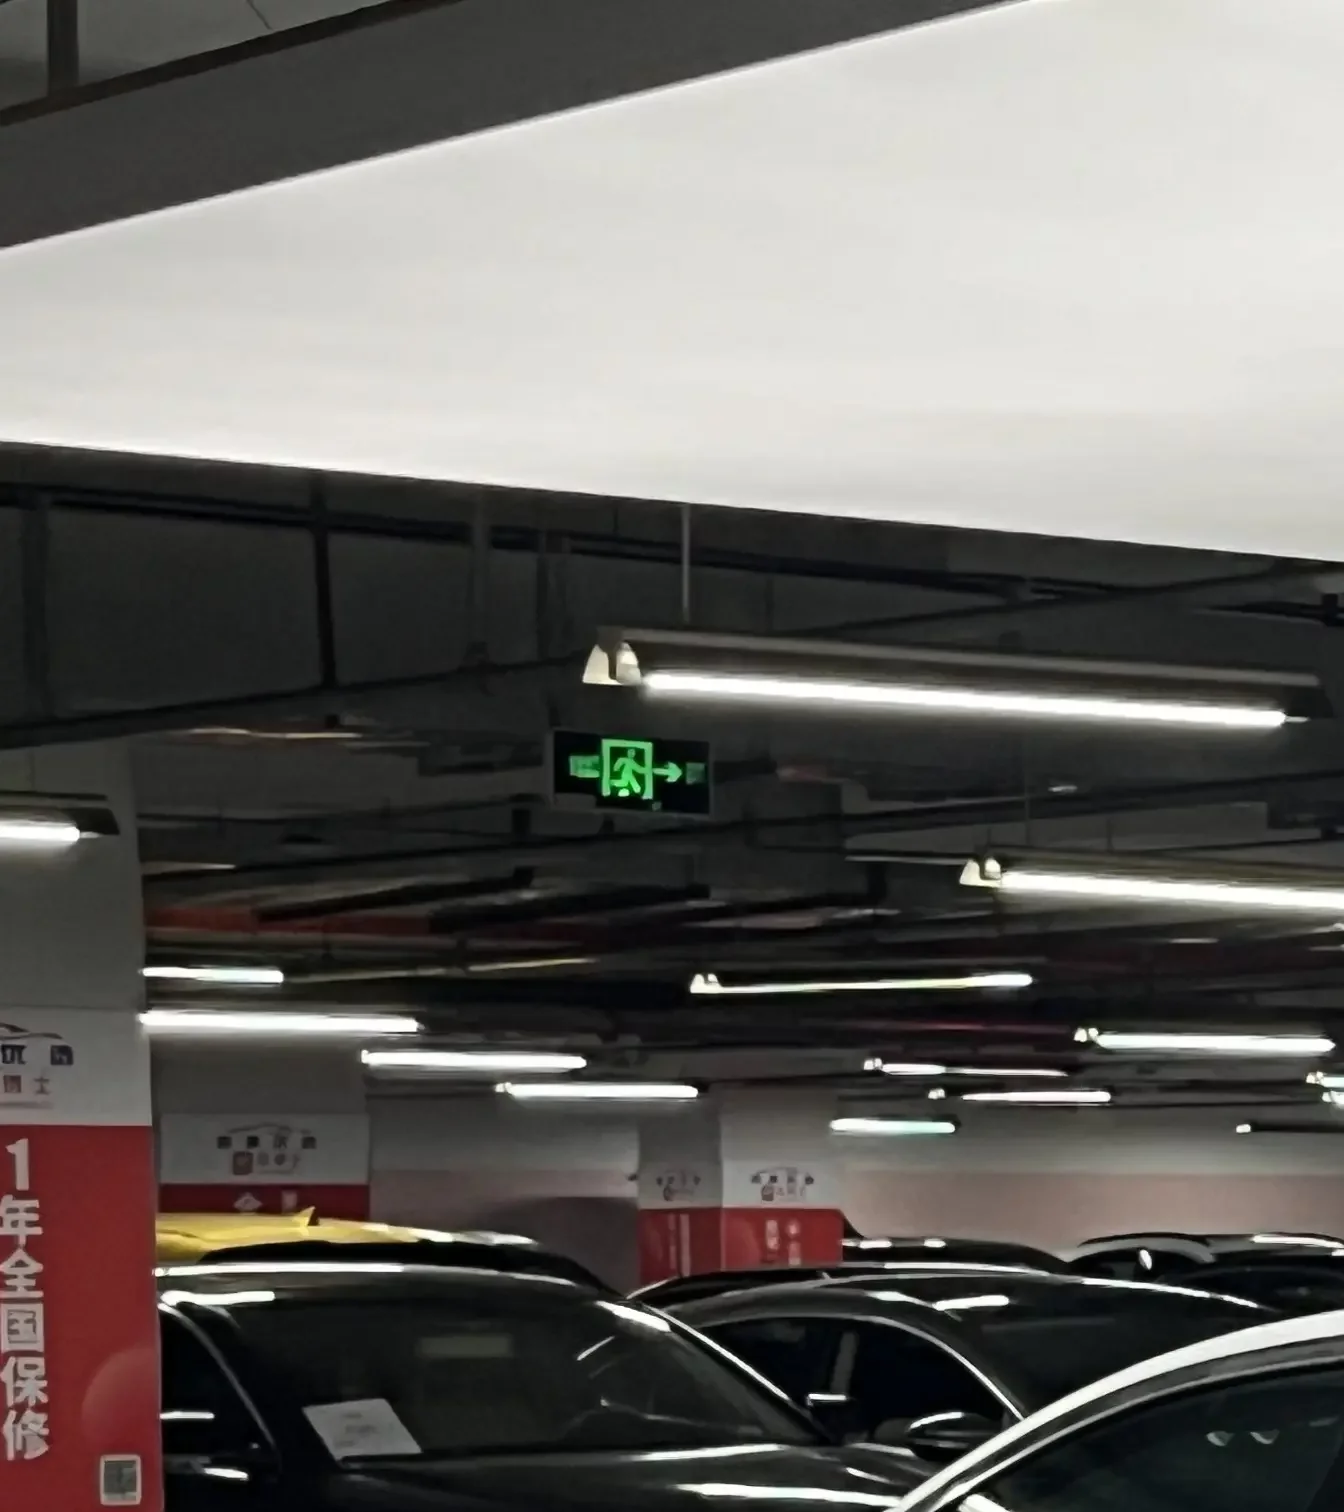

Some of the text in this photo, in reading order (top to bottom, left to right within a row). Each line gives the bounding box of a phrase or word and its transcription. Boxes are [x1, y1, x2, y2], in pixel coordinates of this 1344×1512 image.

[0, 1137, 50, 1462] 1年全国保修
